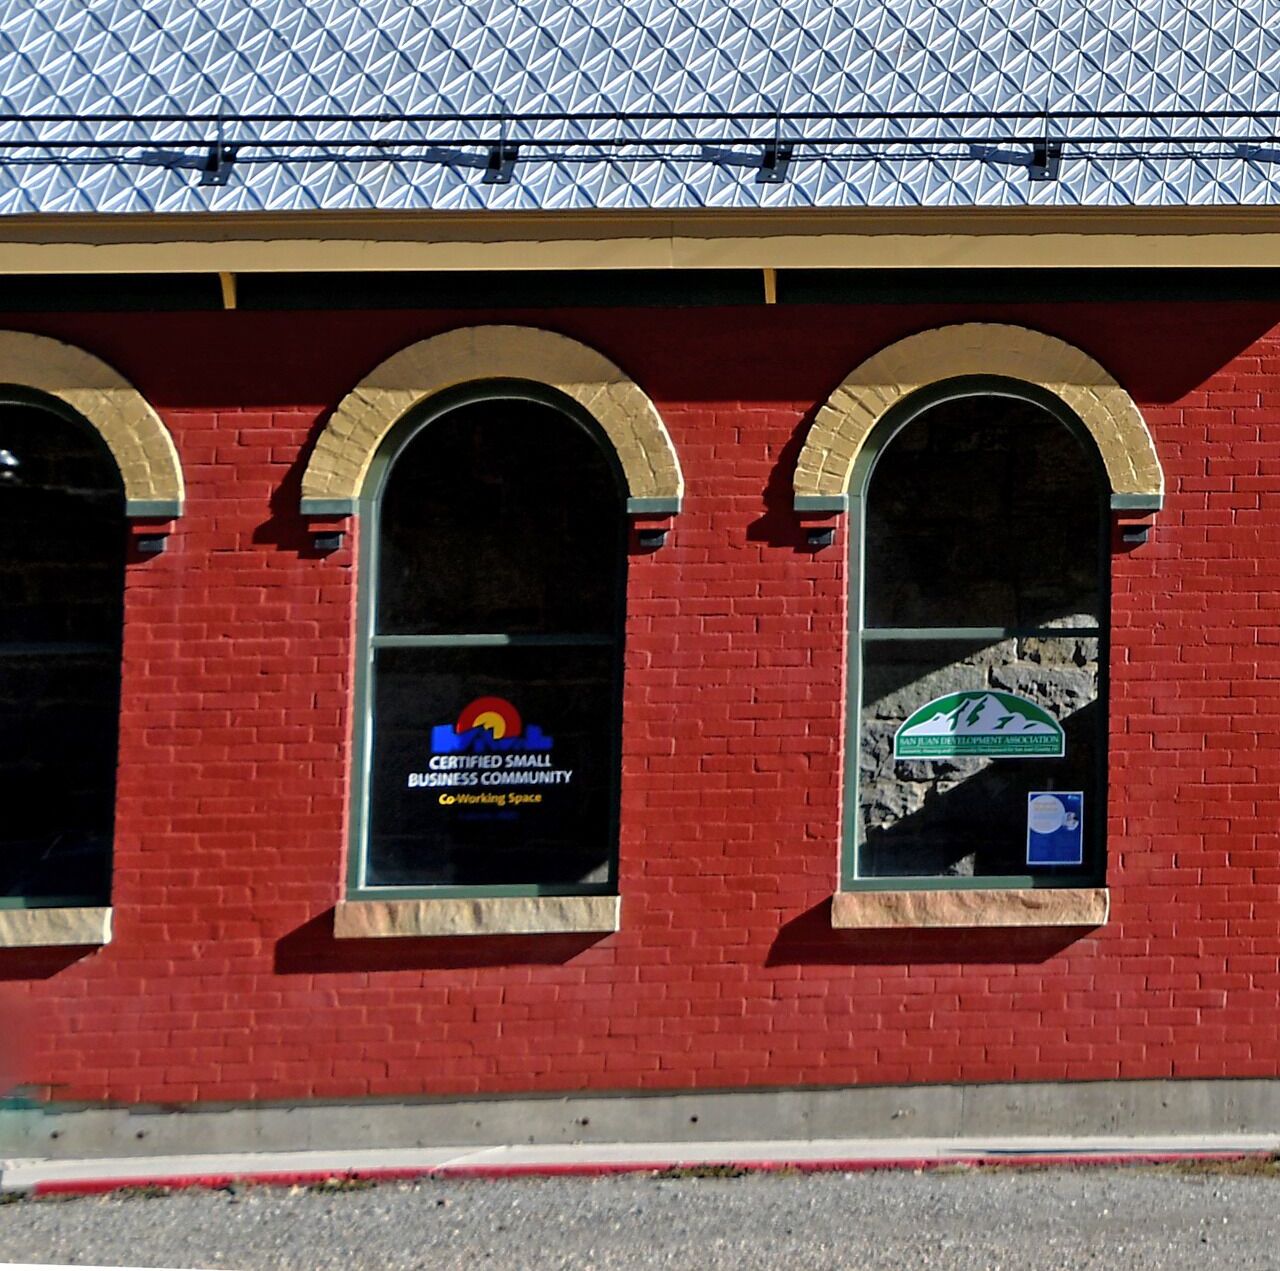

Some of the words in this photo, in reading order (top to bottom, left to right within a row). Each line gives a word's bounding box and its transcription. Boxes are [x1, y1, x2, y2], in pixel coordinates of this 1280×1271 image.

[899, 735, 917, 746] SAN
[917, 735, 939, 747] JUAN
[940, 735, 1003, 746] DEVELOPMENT
[1004, 734, 1060, 745] ASSOCIATION
[428, 754, 503, 770] CERTIFIED
[504, 753, 553, 768] SMALL
[407, 771, 479, 788] BUSINESS
[480, 769, 574, 786] COMMUNITY
[438, 792, 506, 807] Co-Working
[507, 792, 543, 806] Space
